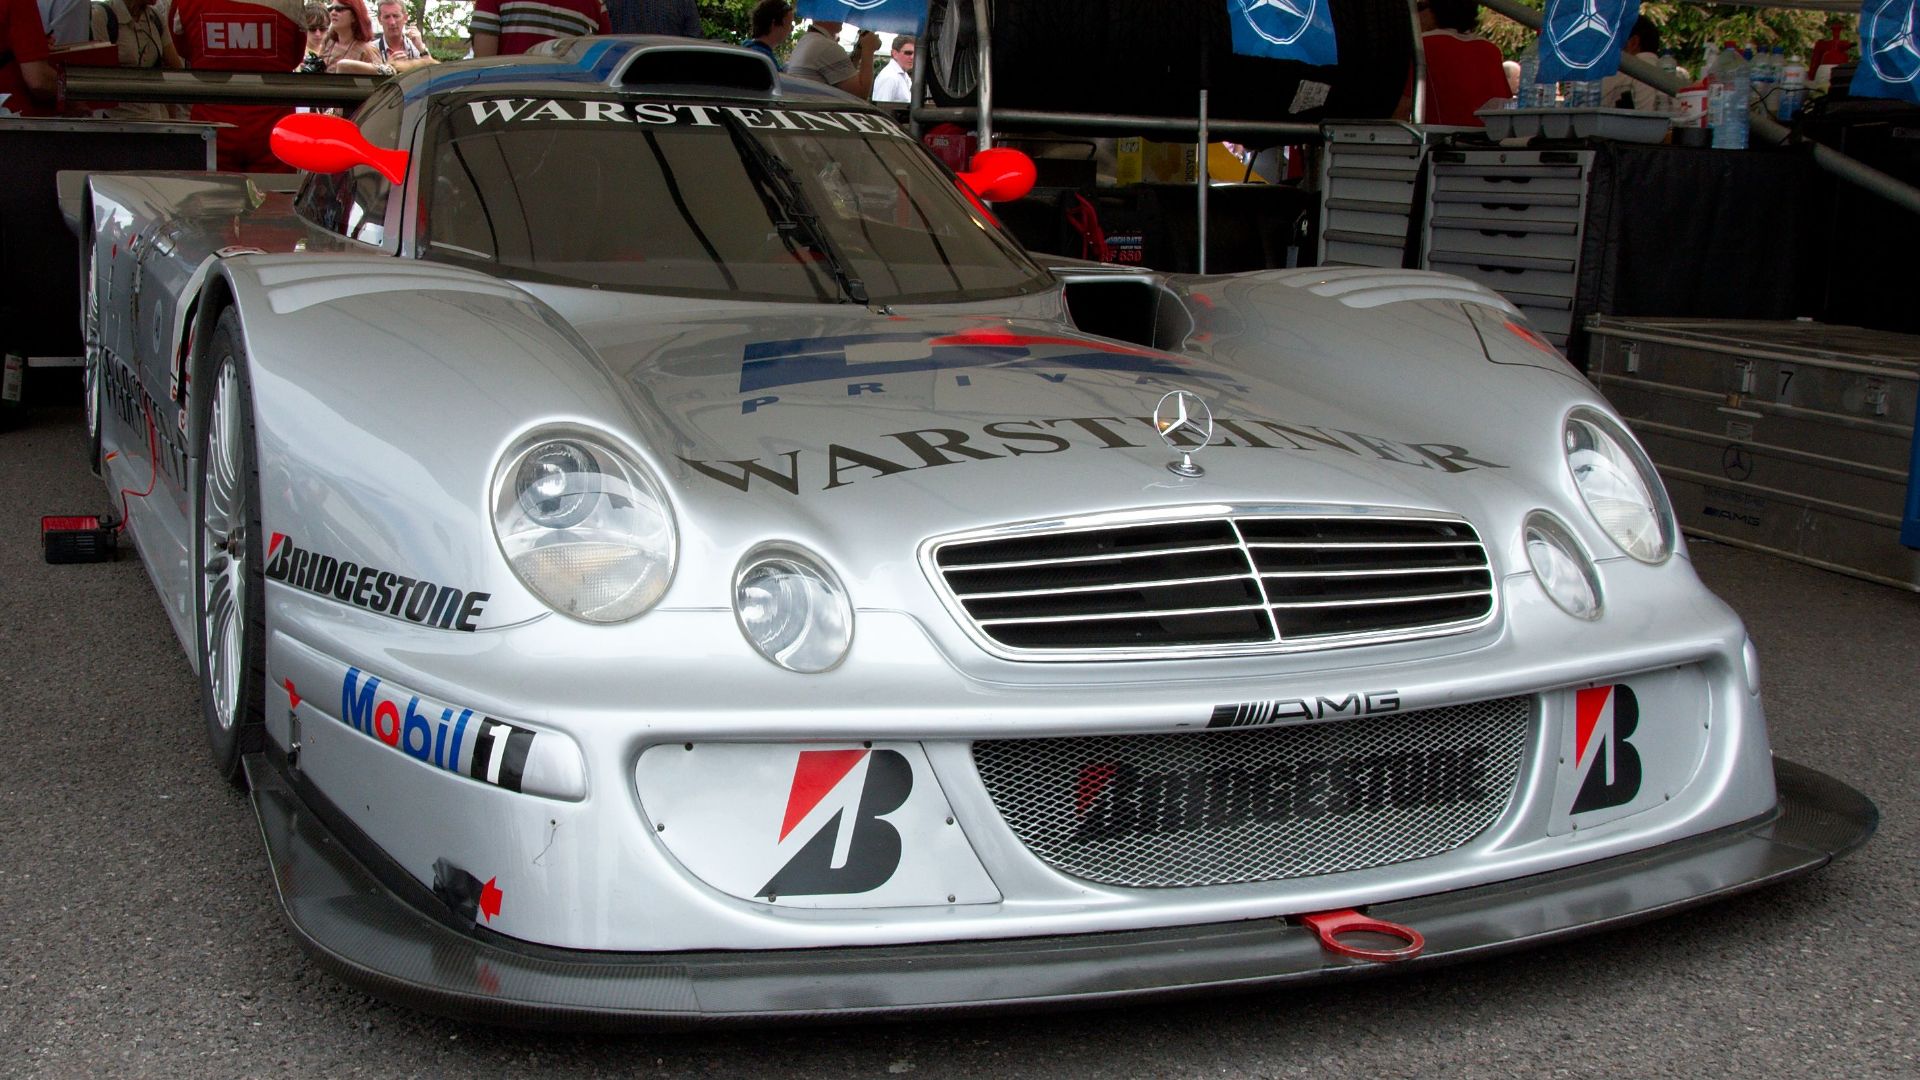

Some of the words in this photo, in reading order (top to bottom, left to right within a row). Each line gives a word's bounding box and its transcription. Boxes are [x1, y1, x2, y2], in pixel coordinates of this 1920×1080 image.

[206, 22, 272, 49] EMI
[467, 97, 917, 144] WARSTEINER
[1781, 370, 1794, 396] 7
[676, 416, 1510, 495] WARSTEINER
[265, 532, 492, 632] BRIDGESTONE
[342, 667, 474, 773] Mobil
[486, 724, 513, 785] 1
[1264, 690, 1401, 721] AMG
